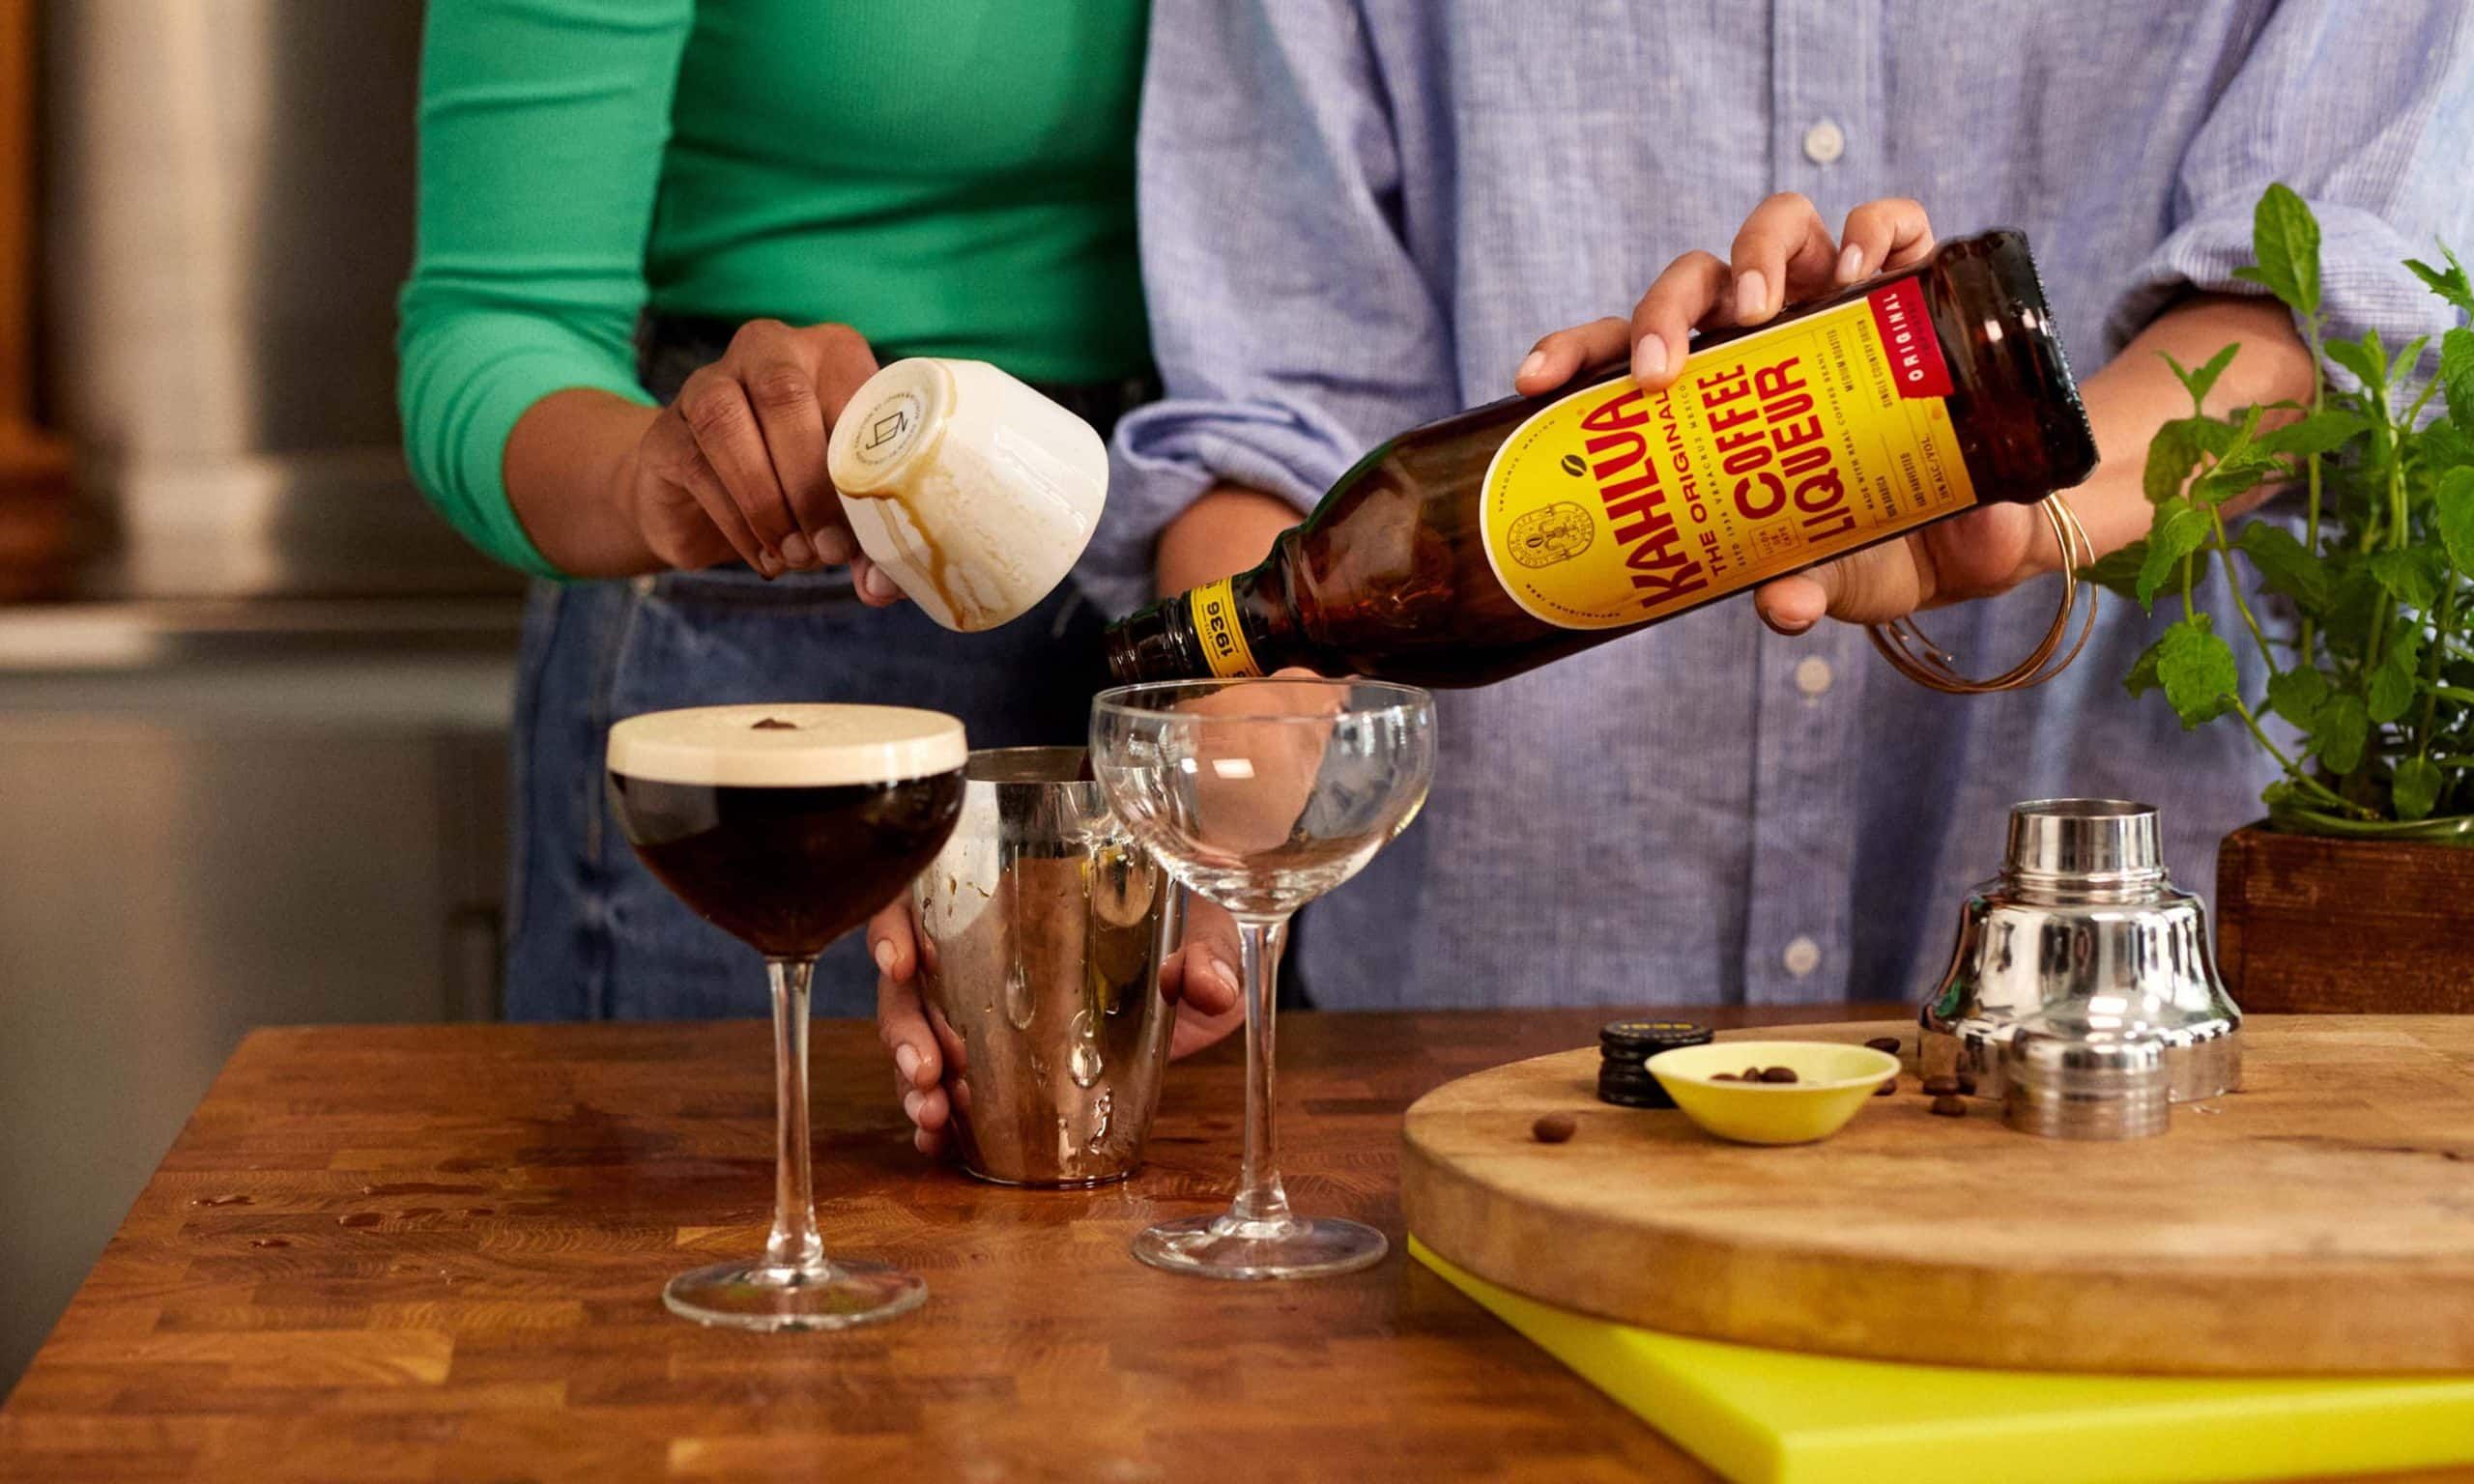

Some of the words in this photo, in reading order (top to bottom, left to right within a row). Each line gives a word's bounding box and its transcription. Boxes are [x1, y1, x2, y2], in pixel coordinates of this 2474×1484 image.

[1826, 328, 1844, 358] ROASTED
[1856, 319, 1871, 342] ORIGIN
[1883, 292, 1924, 381] ORIGINAL
[1816, 352, 1831, 383] BEANS
[1835, 359, 1855, 392] MEDIUM
[1862, 343, 1883, 378] COUNTRY
[1826, 385, 1846, 426] COFFEE
[1875, 379, 1893, 408] SINGLE
[1654, 387, 1706, 523] ORIGINAL
[1696, 363, 1785, 518] COFFEE
[1752, 356, 1856, 543] LIQUEUR
[1841, 429, 1856, 456] REAL
[1850, 458, 1864, 483] WITH
[1859, 486, 1874, 510] MADE
[1699, 528, 1727, 577] THE
[1207, 601, 1234, 658] 1936
